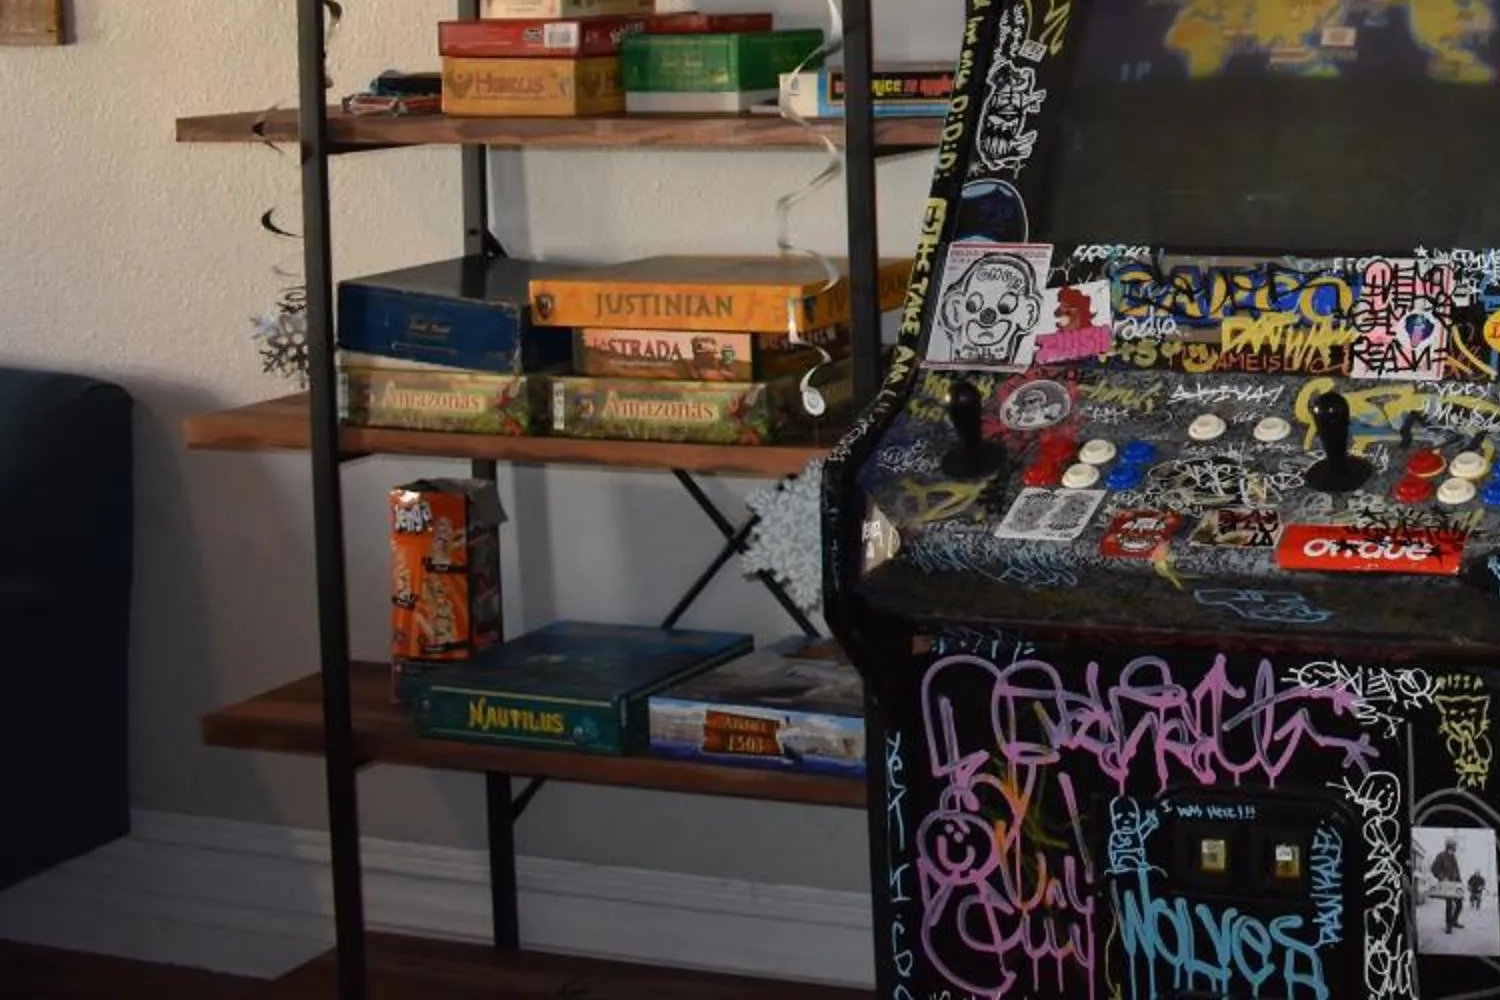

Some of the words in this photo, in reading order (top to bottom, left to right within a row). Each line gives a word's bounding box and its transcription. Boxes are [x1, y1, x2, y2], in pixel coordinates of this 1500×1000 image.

[595, 292, 735, 318] JUSTINIAN
[608, 337, 682, 361] STRADA
[384, 380, 480, 410] Amazonas
[601, 390, 717, 422] Amazonas
[467, 697, 565, 735] NAUTILUS
